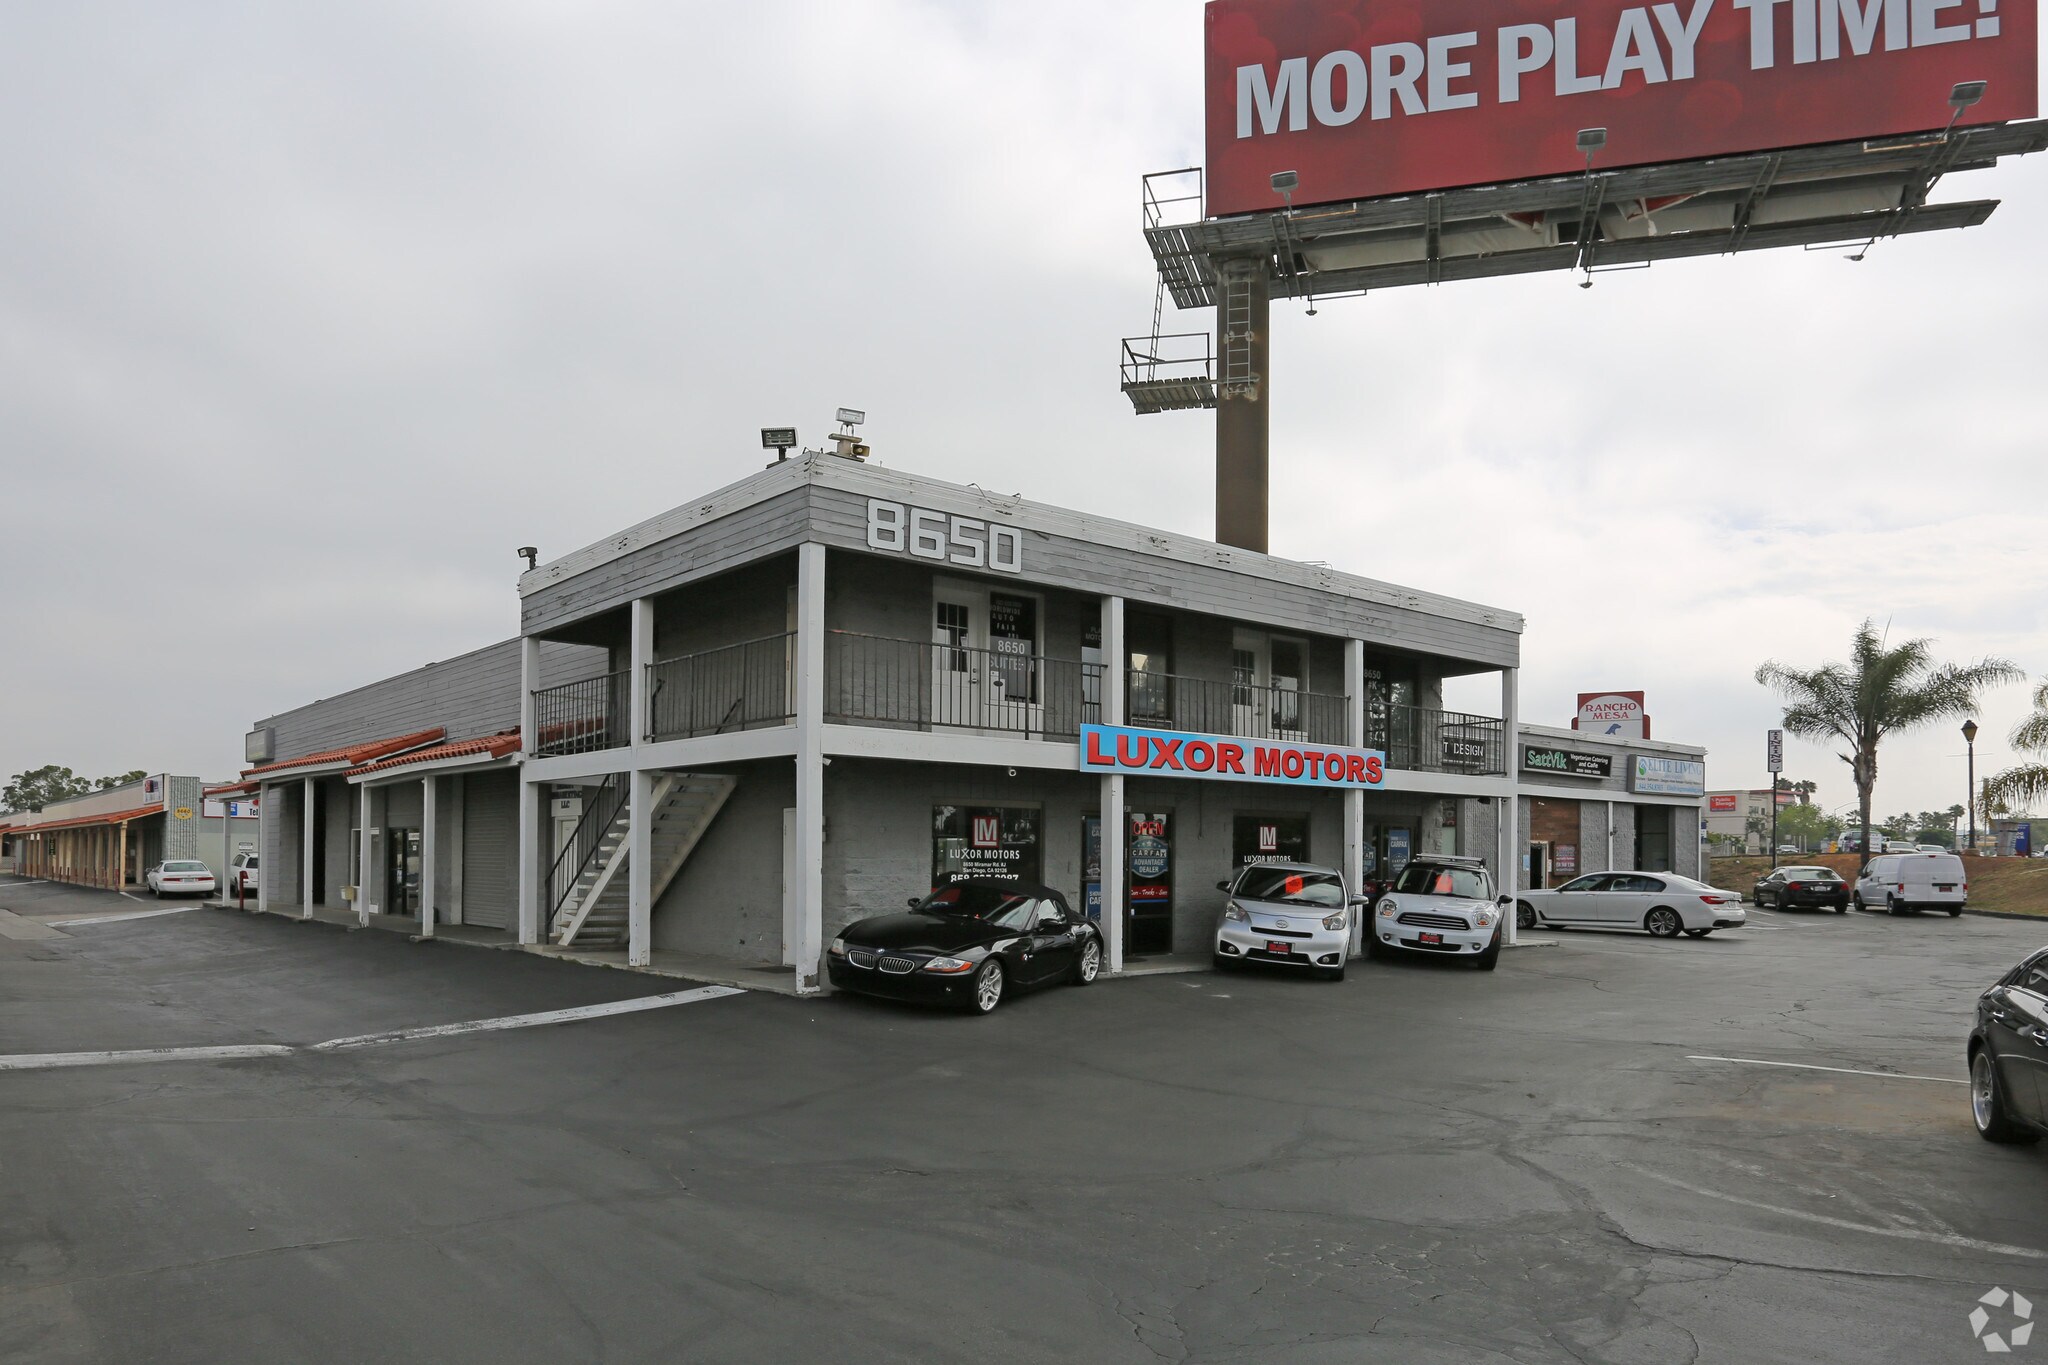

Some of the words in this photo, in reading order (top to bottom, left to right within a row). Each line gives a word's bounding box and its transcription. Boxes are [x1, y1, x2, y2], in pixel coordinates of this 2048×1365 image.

[1236, 32, 1479, 139] MORE
[1498, 0, 1712, 104] PLAY
[867, 498, 1022, 574] 8650
[998, 640, 1025, 655] 8650
[1364, 669, 1381, 680] 8650
[1585, 702, 1637, 712] RANCHO
[1592, 711, 1630, 720] MESA
[1453, 743, 1484, 756] DESIGN
[1086, 732, 1247, 774] LUXOR
[1254, 747, 1384, 784] MOTORS
[1648, 759, 1672, 772] ELITE
[1674, 762, 1702, 775] LIVING
[1133, 821, 1164, 835] OPEN
[950, 848, 982, 860] LUXOR
[984, 850, 1020, 860] MOTORS
[1243, 855, 1266, 863] LUXOR
[1266, 855, 1291, 863] MOTORS
[1134, 858, 1164, 866] ADVANTAGE
